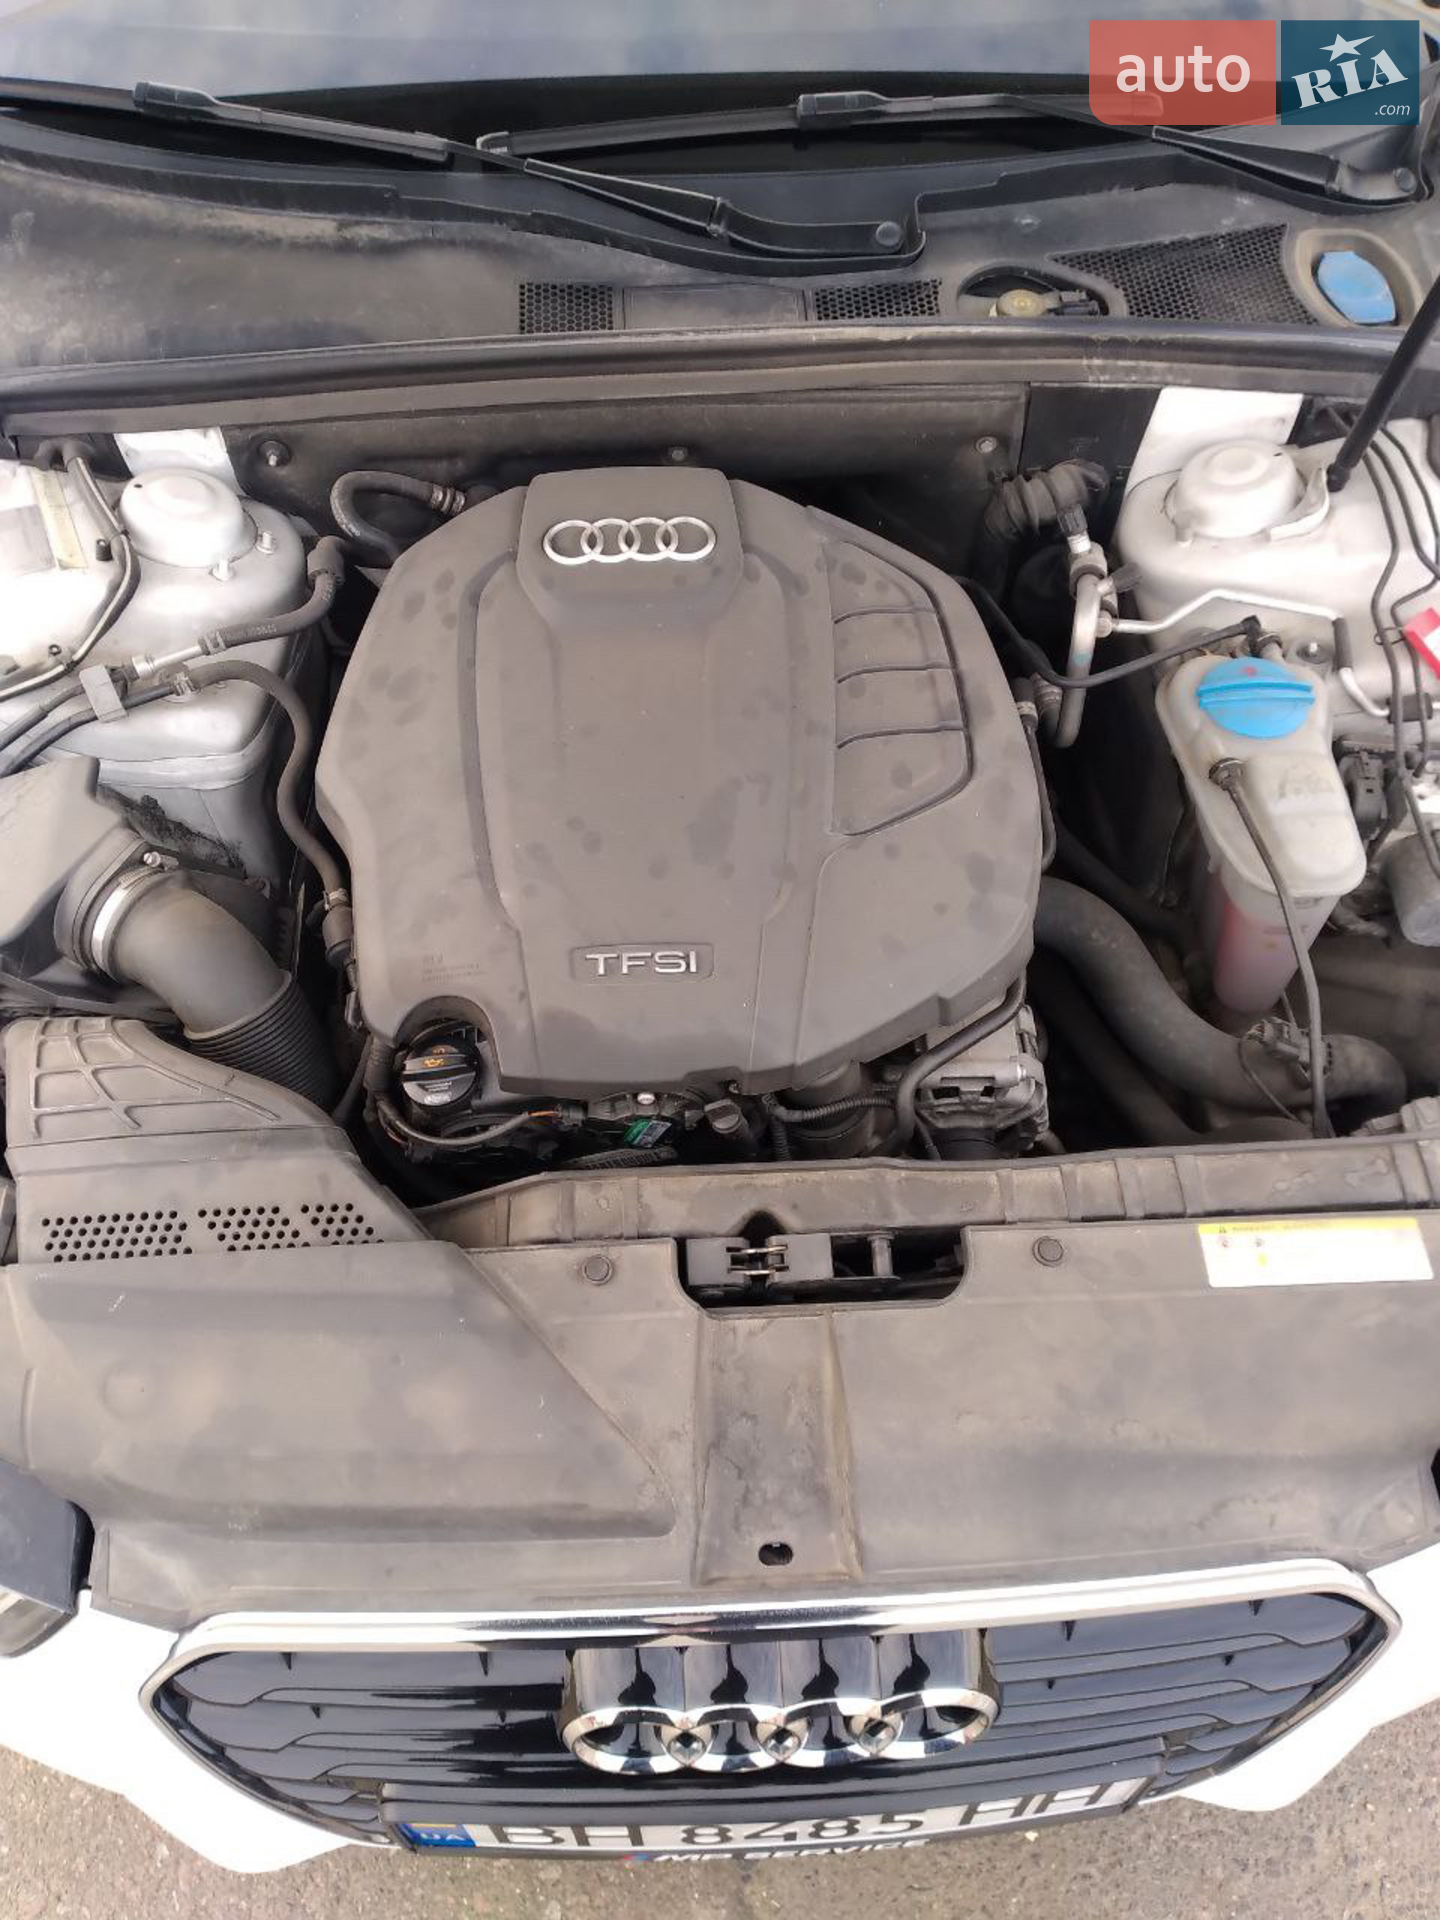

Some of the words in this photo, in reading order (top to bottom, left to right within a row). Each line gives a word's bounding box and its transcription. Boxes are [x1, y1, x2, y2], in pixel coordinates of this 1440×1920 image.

[585, 950, 697, 976] TFSI
[488, 1824, 644, 1847] BH
[681, 1814, 924, 1846] 8485
